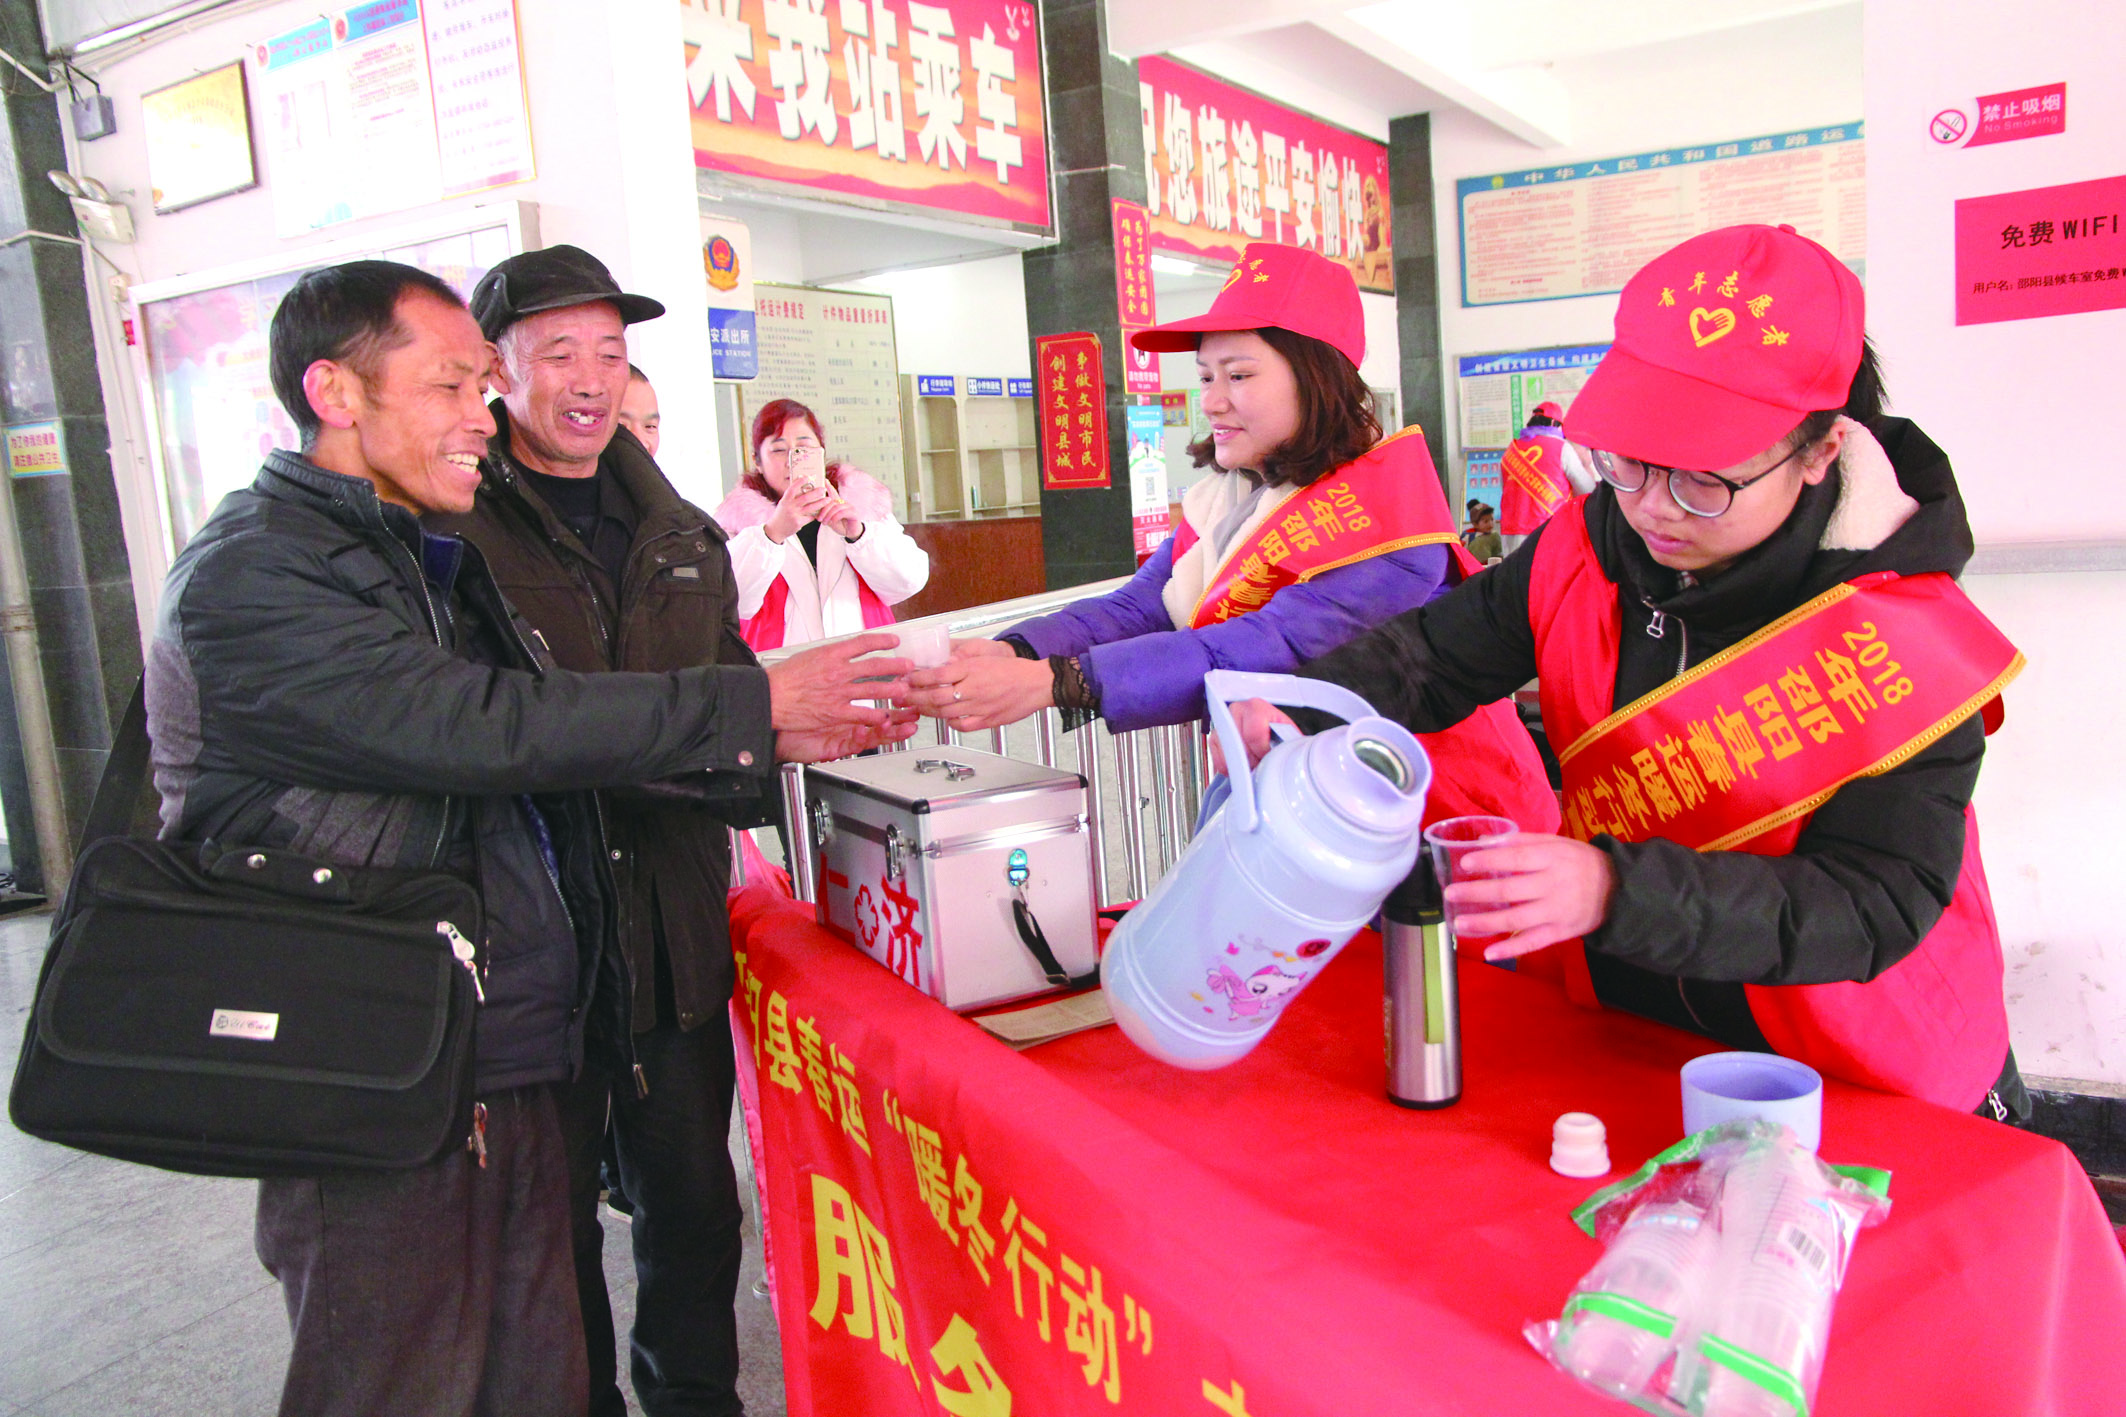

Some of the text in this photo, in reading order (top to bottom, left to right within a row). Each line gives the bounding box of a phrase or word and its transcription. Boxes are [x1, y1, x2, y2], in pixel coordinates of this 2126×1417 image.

[1982, 93, 2062, 122] 禁止吸烟
[1984, 114, 2059, 133] No Smoking
[2001, 214, 2118, 250] 免费 WIFI
[1657, 270, 1790, 346] 青年志愿者
[1049, 353, 1074, 470] 创建文明县城
[1074, 351, 1097, 468] 争做文明市民
